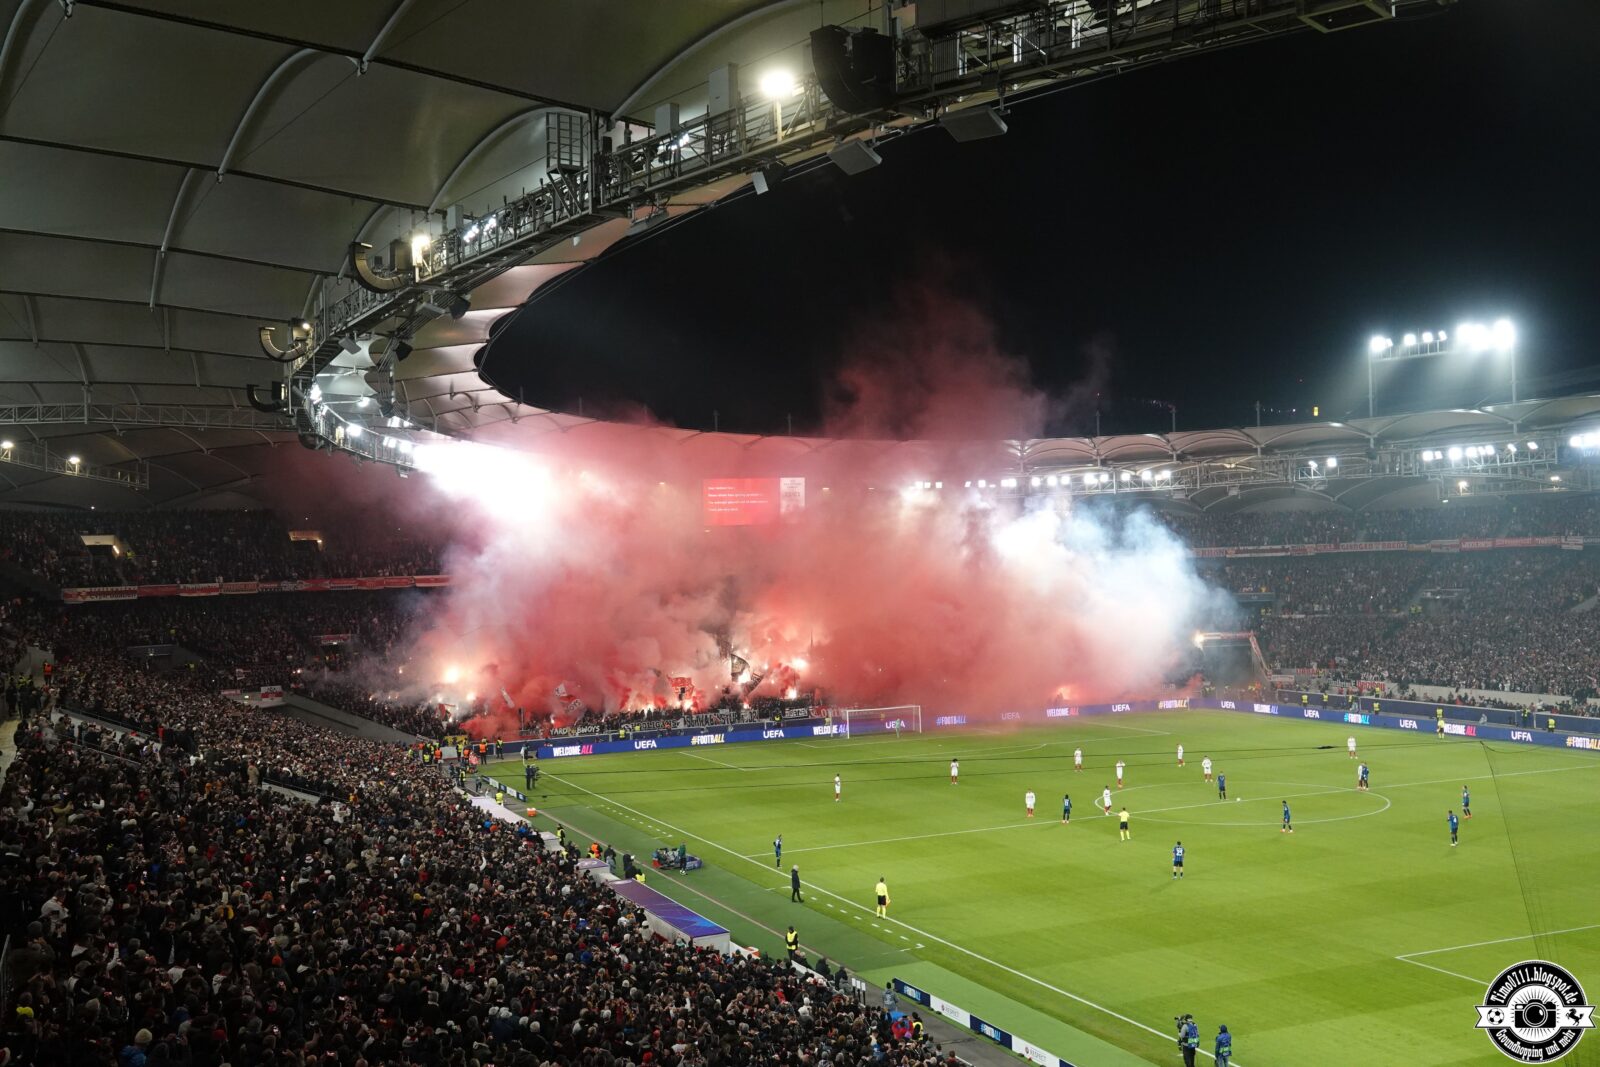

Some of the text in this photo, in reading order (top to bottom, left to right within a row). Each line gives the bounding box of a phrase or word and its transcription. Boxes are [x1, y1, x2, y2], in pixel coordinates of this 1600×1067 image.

[1112, 704, 1130, 712] UEFA
[1221, 701, 1235, 709] UEFA
[1270, 705, 1278, 714] ALL
[1001, 712, 1021, 720] UEFA
[1304, 709, 1320, 719] UEFA
[885, 720, 905, 729] UEA
[1399, 719, 1417, 729] UEFA
[550, 727, 568, 735] YARD
[763, 729, 784, 739] UEFA
[1465, 725, 1476, 736] ALL
[691, 734, 725, 745] #FOOTBALL
[634, 740, 657, 749] UEFA
[553, 744, 593, 757] WELCOME ALL
